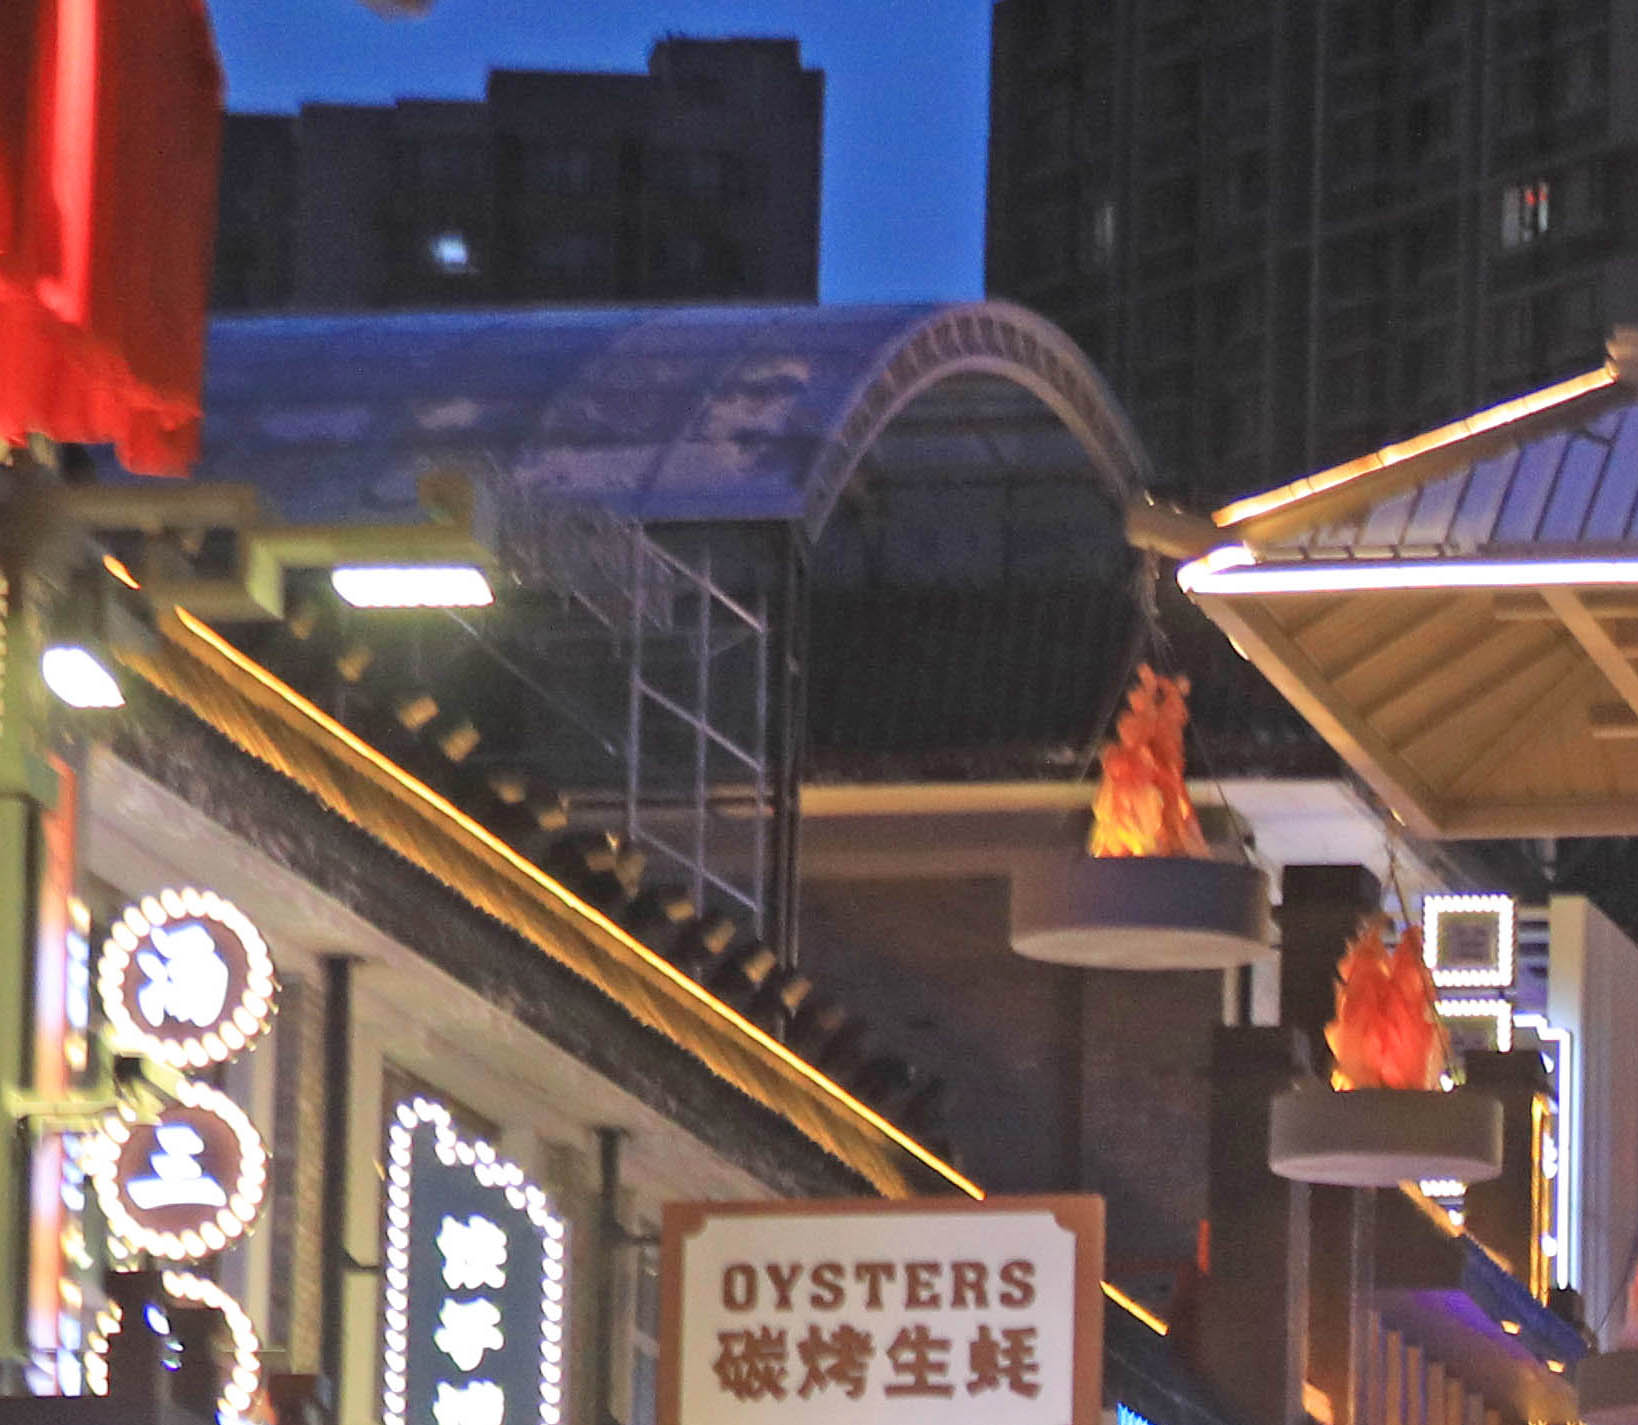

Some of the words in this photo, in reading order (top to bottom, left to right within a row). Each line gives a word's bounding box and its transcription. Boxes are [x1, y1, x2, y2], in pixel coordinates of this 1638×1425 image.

[720, 1259, 1036, 1312] OYSTERS
[712, 1323, 1042, 1401] 碳烤生蚝
